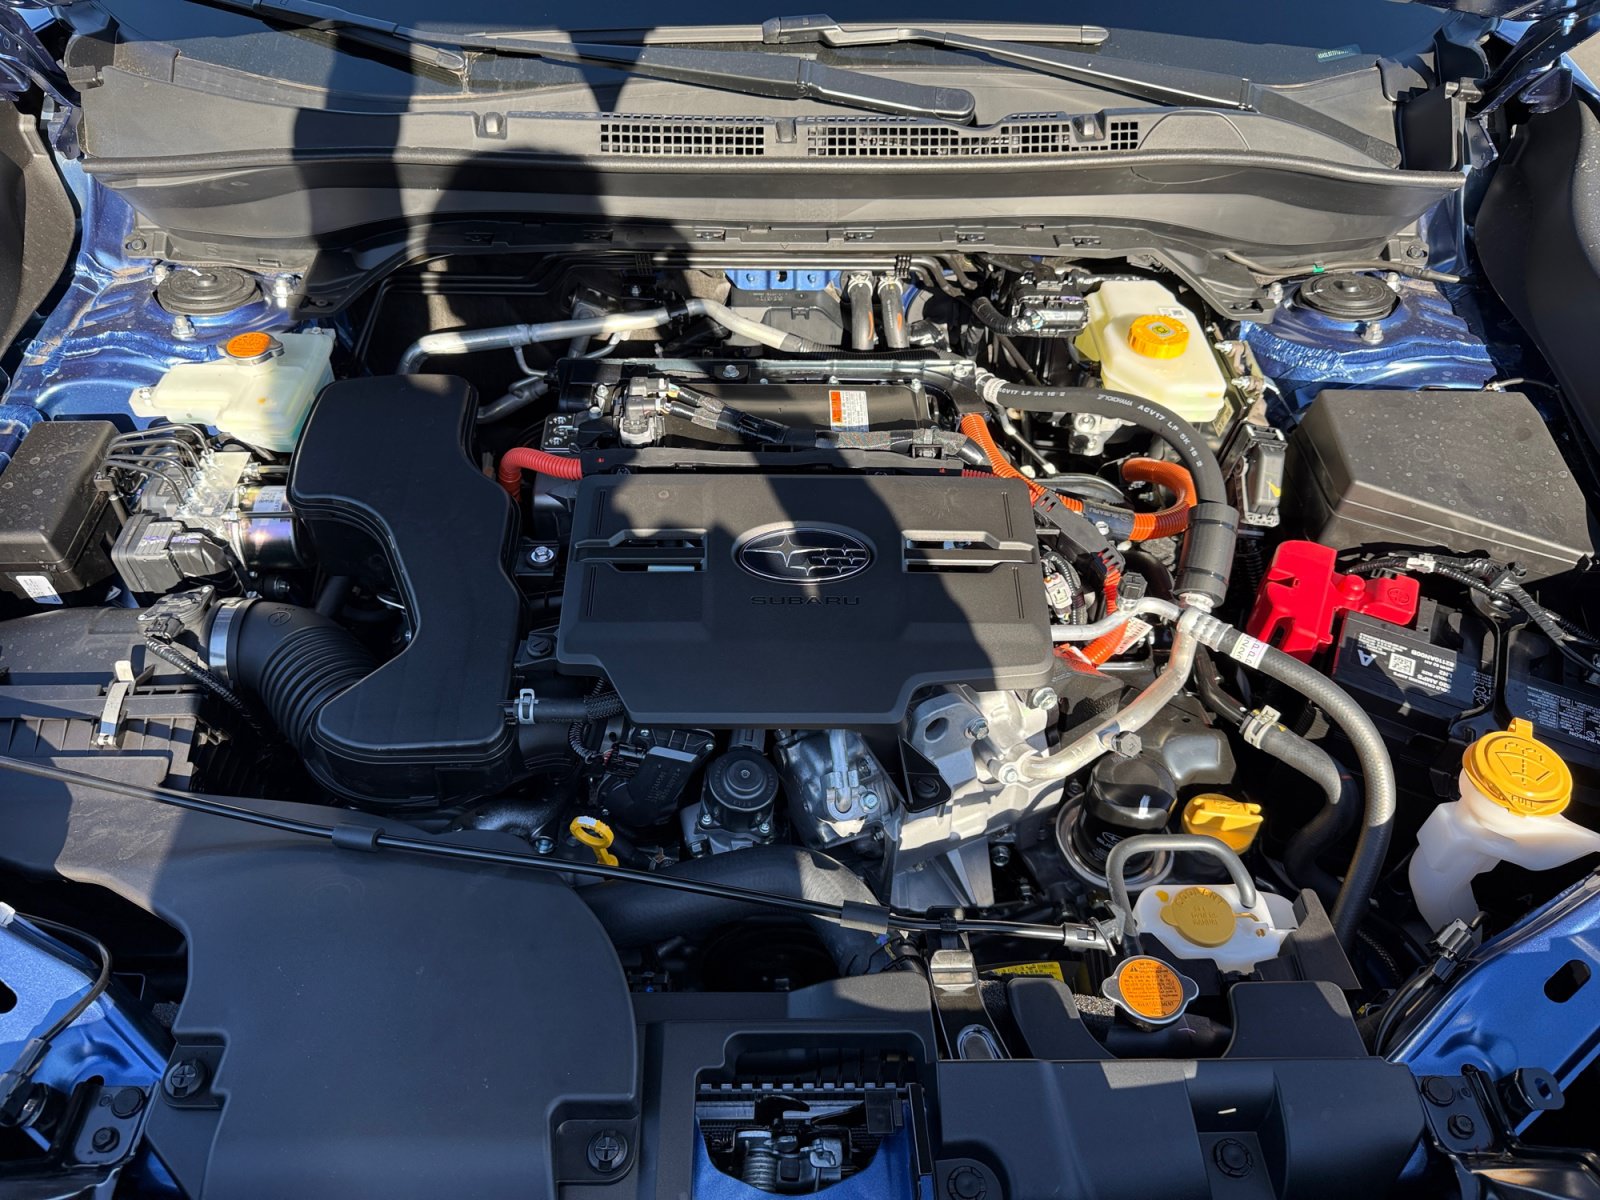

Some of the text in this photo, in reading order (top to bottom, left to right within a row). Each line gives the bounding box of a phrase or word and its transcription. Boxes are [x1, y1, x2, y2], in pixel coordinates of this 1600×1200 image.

[1137, 404, 1166, 421] ACV17
[1166, 421, 1179, 432] LP
[750, 596, 860, 606] SUBARU
